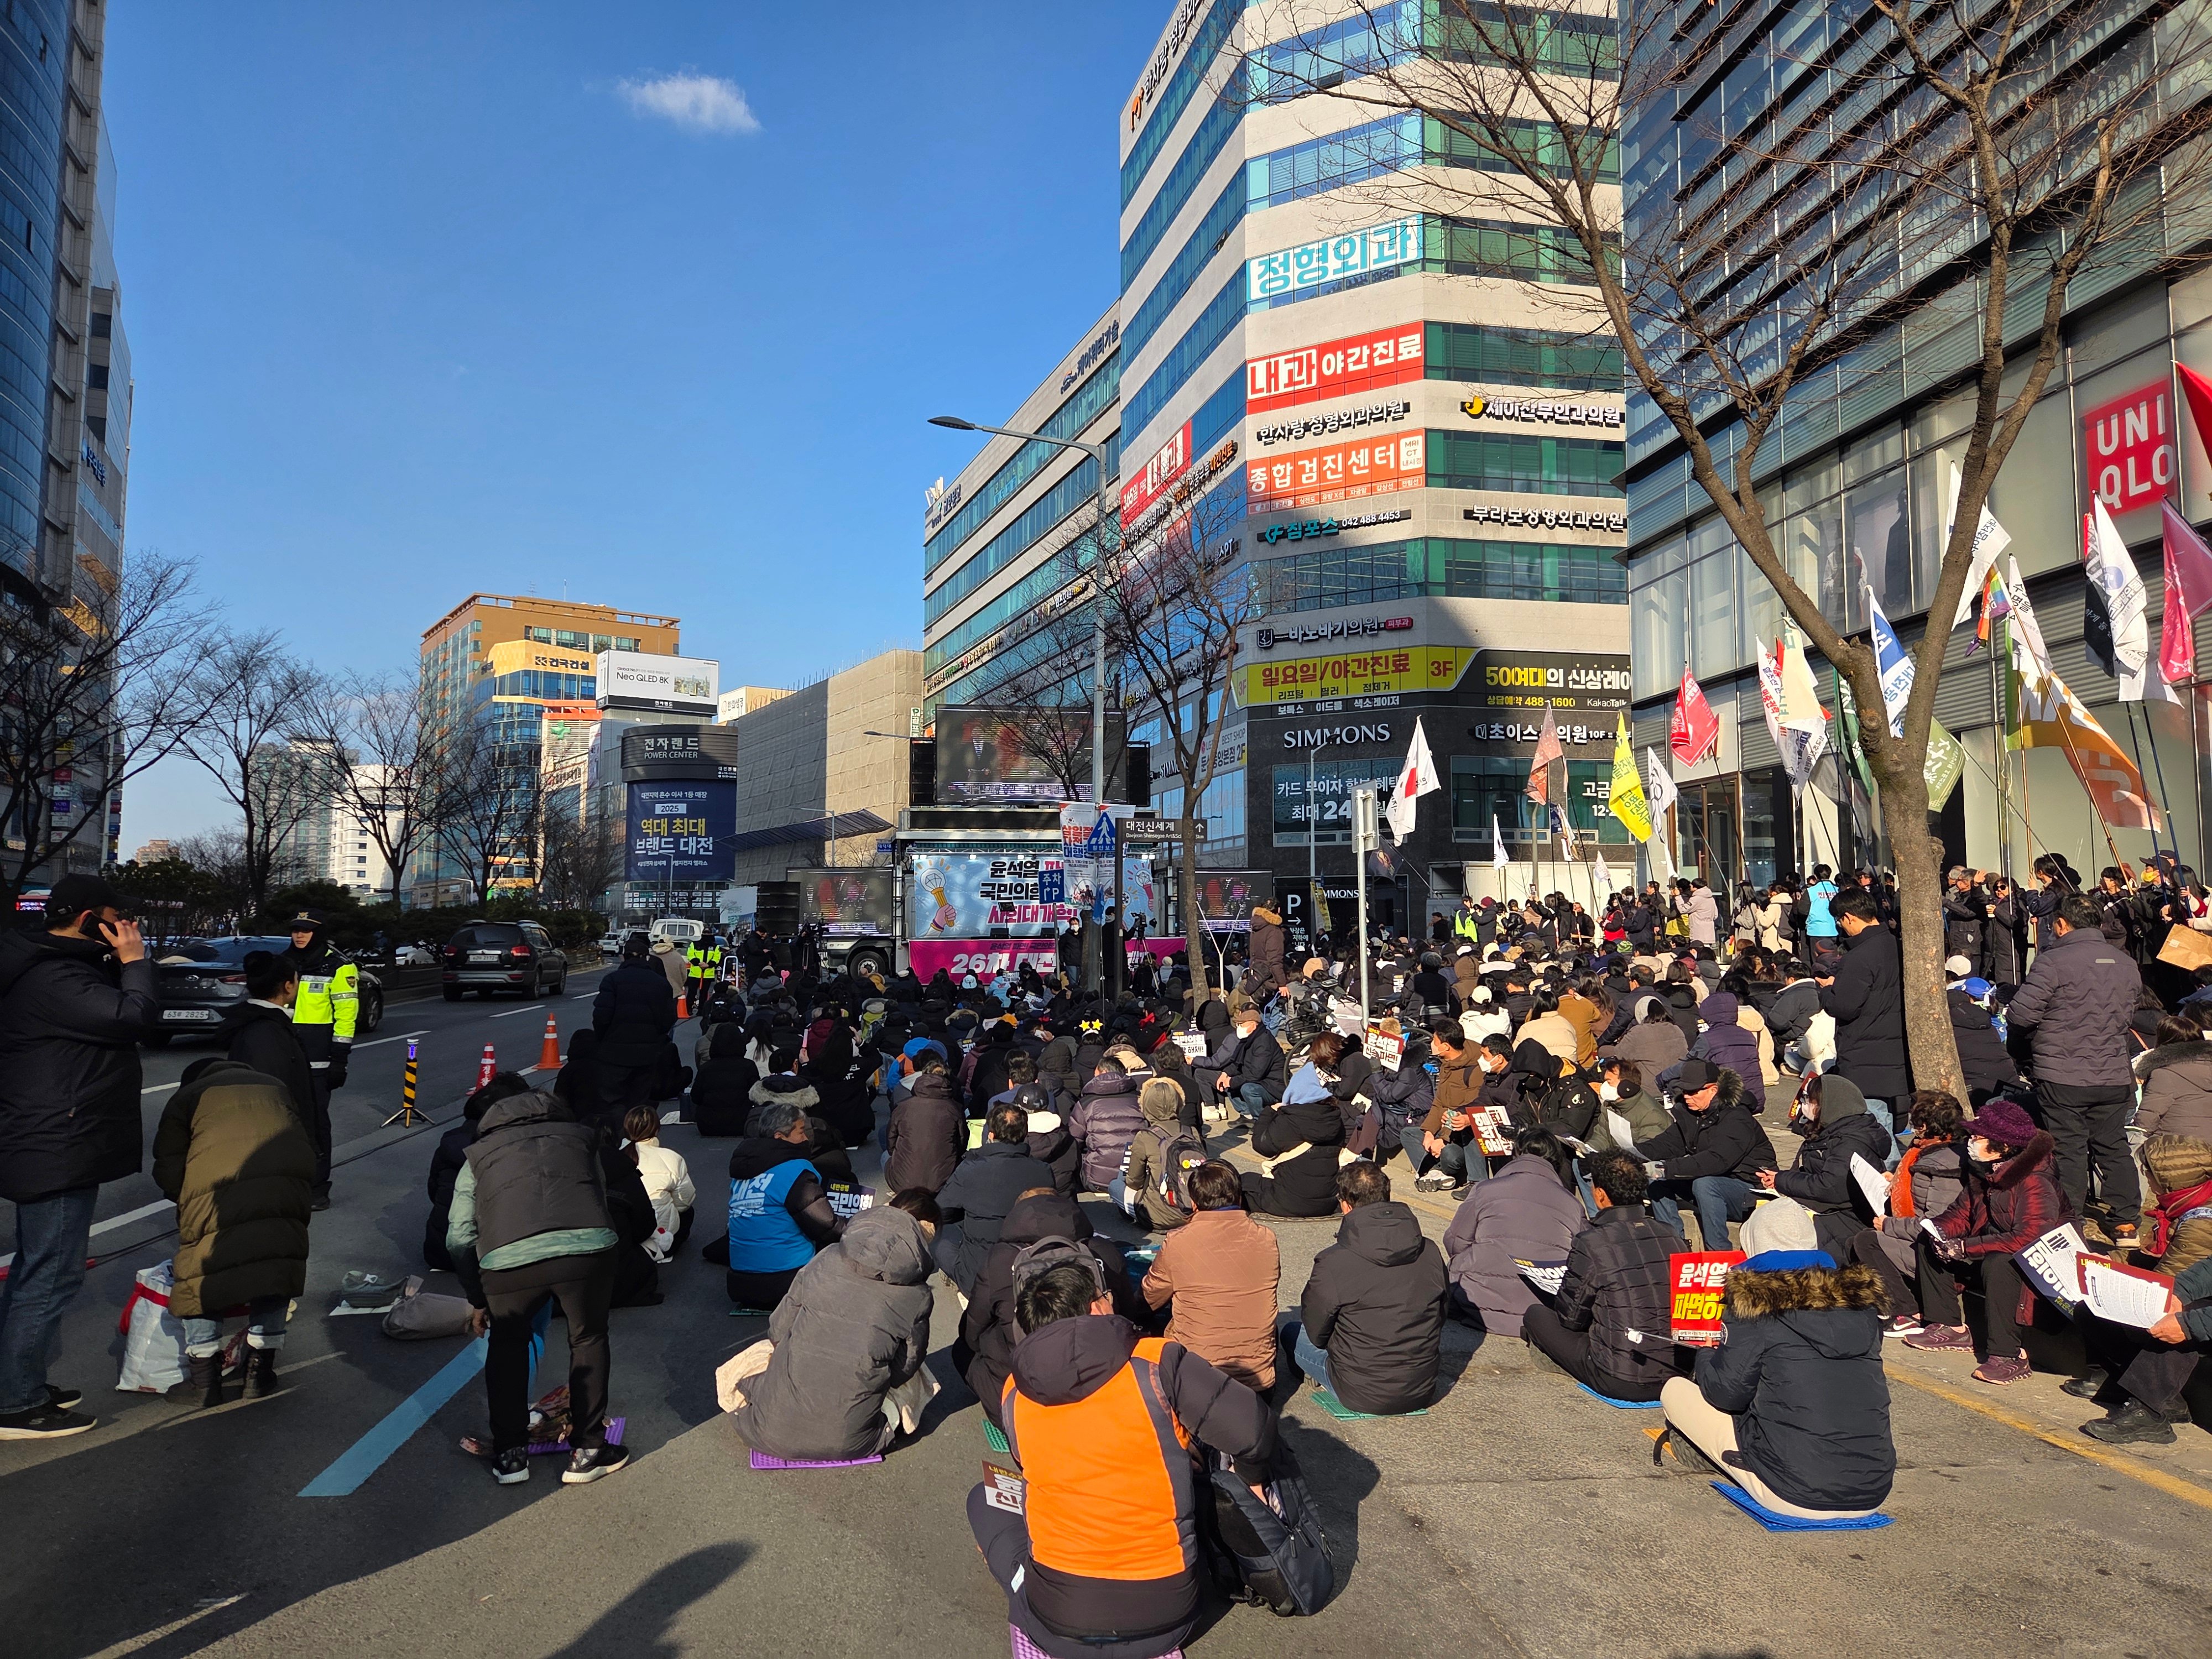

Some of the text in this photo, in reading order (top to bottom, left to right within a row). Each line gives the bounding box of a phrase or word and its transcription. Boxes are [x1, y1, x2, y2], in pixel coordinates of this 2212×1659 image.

[1144, 40, 1170, 106] 한사랑
[1257, 219, 1412, 294] 정형외과
[1249, 333, 1422, 398] 내과 야간진료
[1260, 398, 1405, 444] 한사랑 정형외과의원
[2096, 393, 2166, 456] UNI
[1405, 439, 1419, 447] MRI
[1209, 440, 1235, 471] 야간진료
[1402, 457, 1422, 467] 내시경
[1250, 442, 1396, 493] 종합검진센터
[2099, 444, 2174, 509] QLO
[1322, 492, 1333, 501] 유방
[1350, 487, 1367, 495] 자궁암
[1401, 478, 1419, 487] 전립선
[1287, 511, 1401, 540] 짐포스 042 488 4453
[1288, 615, 1409, 643] 바노바기의원 피부과
[617, 671, 635, 681] Neo
[636, 674, 658, 684] QLED
[659, 676, 670, 685] 8K
[1262, 653, 1453, 687] 일요일/야간진료 3F
[1485, 666, 1564, 688] 50여대의
[1238, 679, 1247, 697] 3F
[1278, 681, 1390, 701] 리프팅 필러 점제거
[1278, 705, 1304, 715] 보톡스
[1354, 696, 1400, 709] 색소레이저
[1486, 695, 1627, 708] 상담예약 488-1600 KakaoTalk
[1222, 728, 1246, 745] BEST SHOP
[1284, 722, 1391, 749] SIMMONS
[1489, 722, 1587, 744] 초이스의원
[1588, 731, 1605, 739] 10F
[644, 737, 699, 751] 전자랜드
[1201, 743, 1246, 773] 둔앙본점 2F
[1277, 781, 1302, 797] 카드
[1305, 776, 1343, 795] 무이자
[1582, 781, 1611, 799] 고금
[1291, 804, 1319, 821] 최대
[641, 818, 706, 837] 역대 최대
[1126, 821, 1175, 832] 대전신세계
[635, 837, 713, 855] 브랜드 대전
[990, 860, 1040, 878] 윤석열
[1042, 871, 1062, 885] 주차
[1052, 888, 1059, 900] P
[1287, 894, 1301, 915] P
[950, 952, 1057, 974] 26차 대전
[1367, 1032, 1400, 1053] 윤석열
[1380, 1051, 1399, 1064] 파면!
[1678, 1262, 1731, 1287] 윤석열
[1672, 1292, 1725, 1321] 파면하
